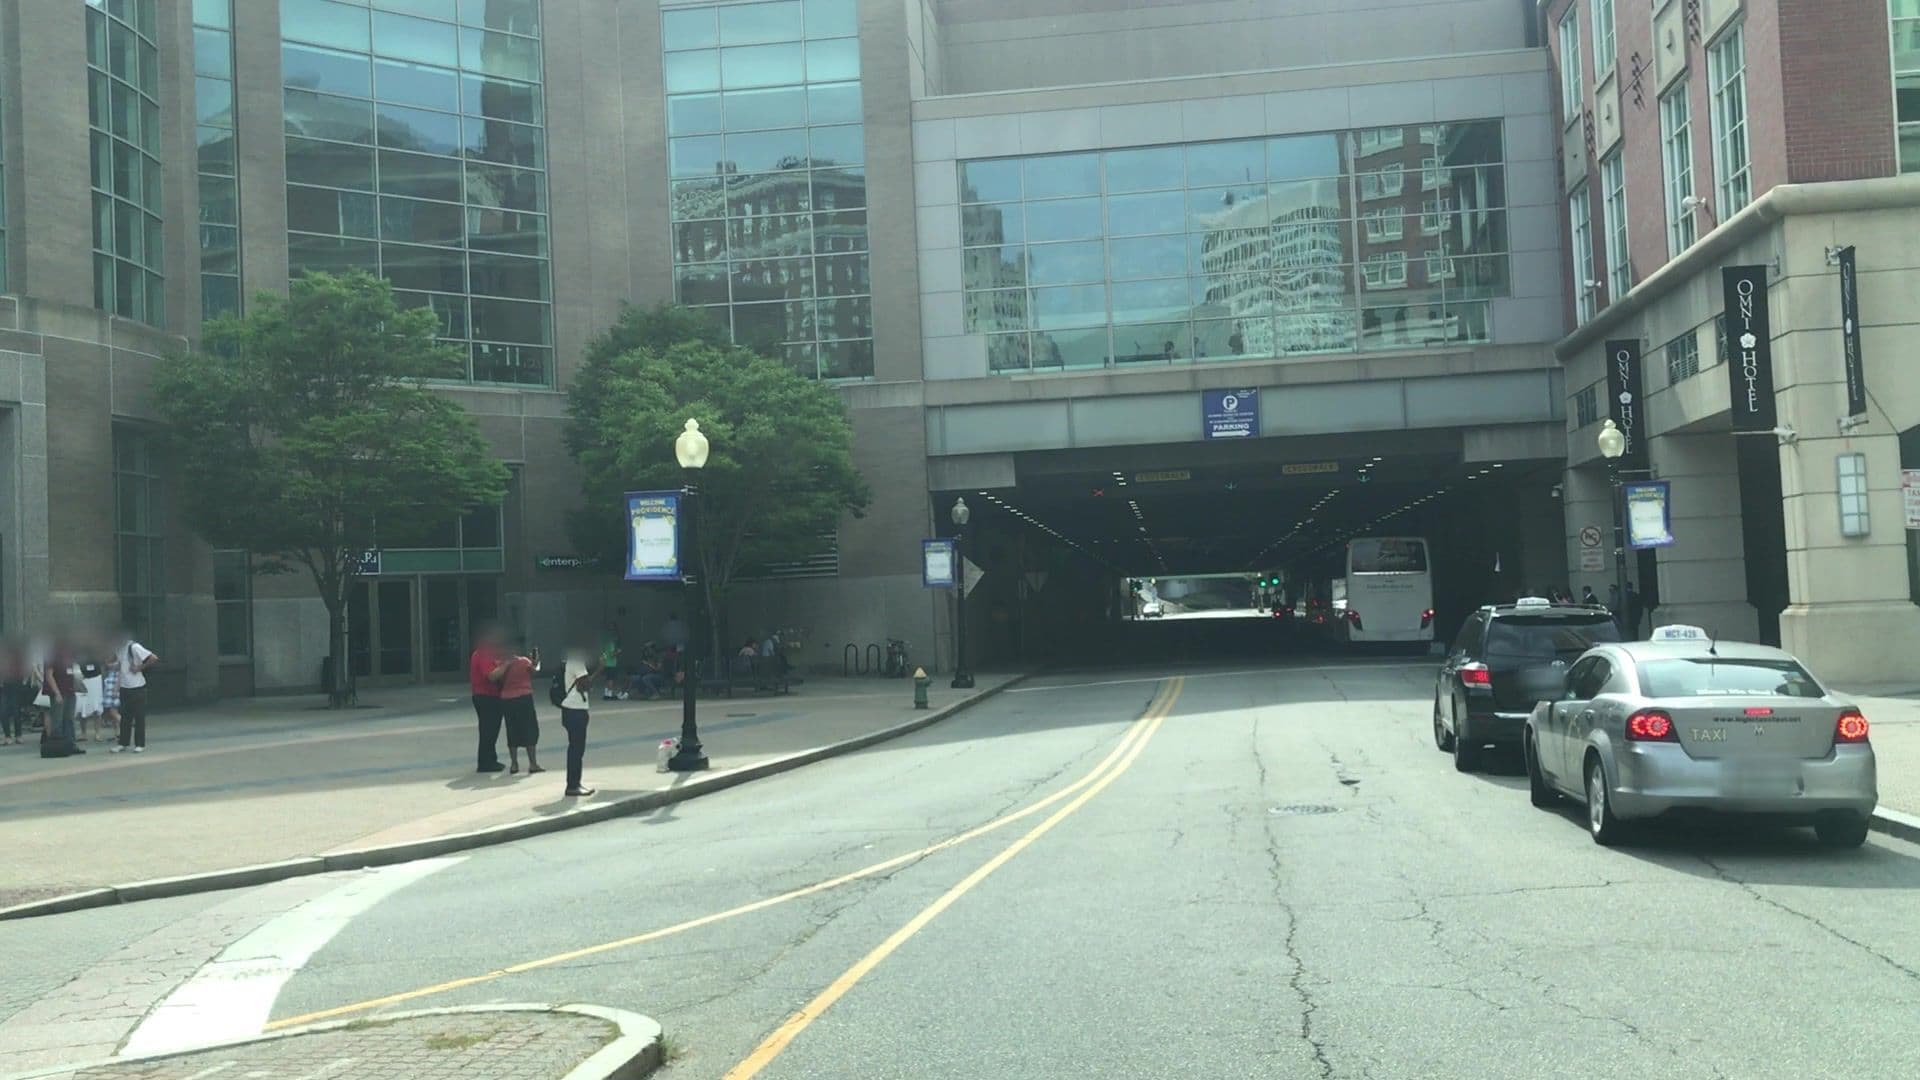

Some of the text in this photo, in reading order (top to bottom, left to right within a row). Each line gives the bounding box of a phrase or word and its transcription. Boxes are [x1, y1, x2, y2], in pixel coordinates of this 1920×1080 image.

[1737, 279, 1758, 412] OMNI HOTEL
[1616, 350, 1633, 454] OMNI HOTEL
[1213, 423, 1250, 431] PARKING
[631, 506, 676, 516] PROVIDENCE
[1691, 728, 1727, 741] TAXI
